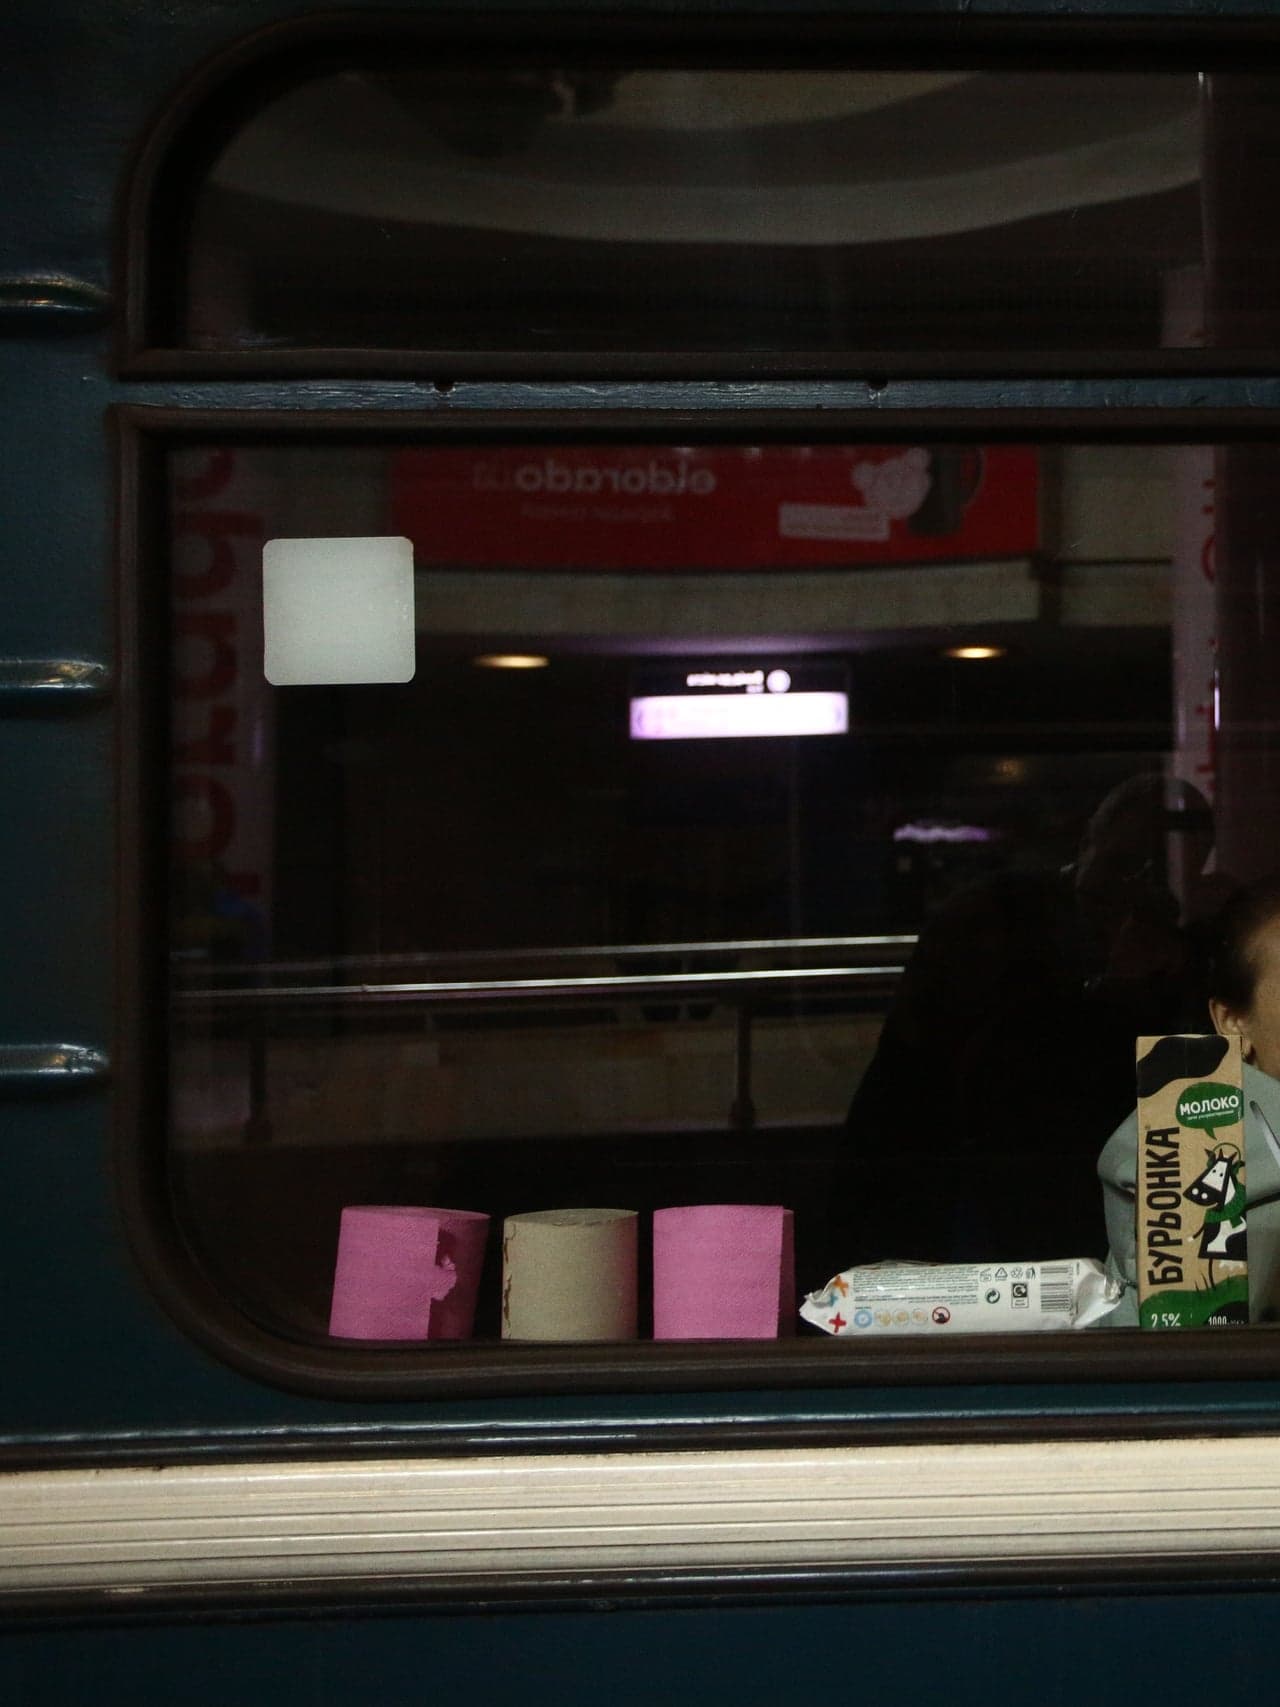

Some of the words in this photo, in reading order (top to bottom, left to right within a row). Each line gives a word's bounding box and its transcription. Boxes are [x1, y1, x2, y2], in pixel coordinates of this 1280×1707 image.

[1179, 1095, 1240, 1116] МОЛОКО
[1145, 1126, 1184, 1286] БУРЬОНКА
[1151, 1312, 1182, 1328] 25%
